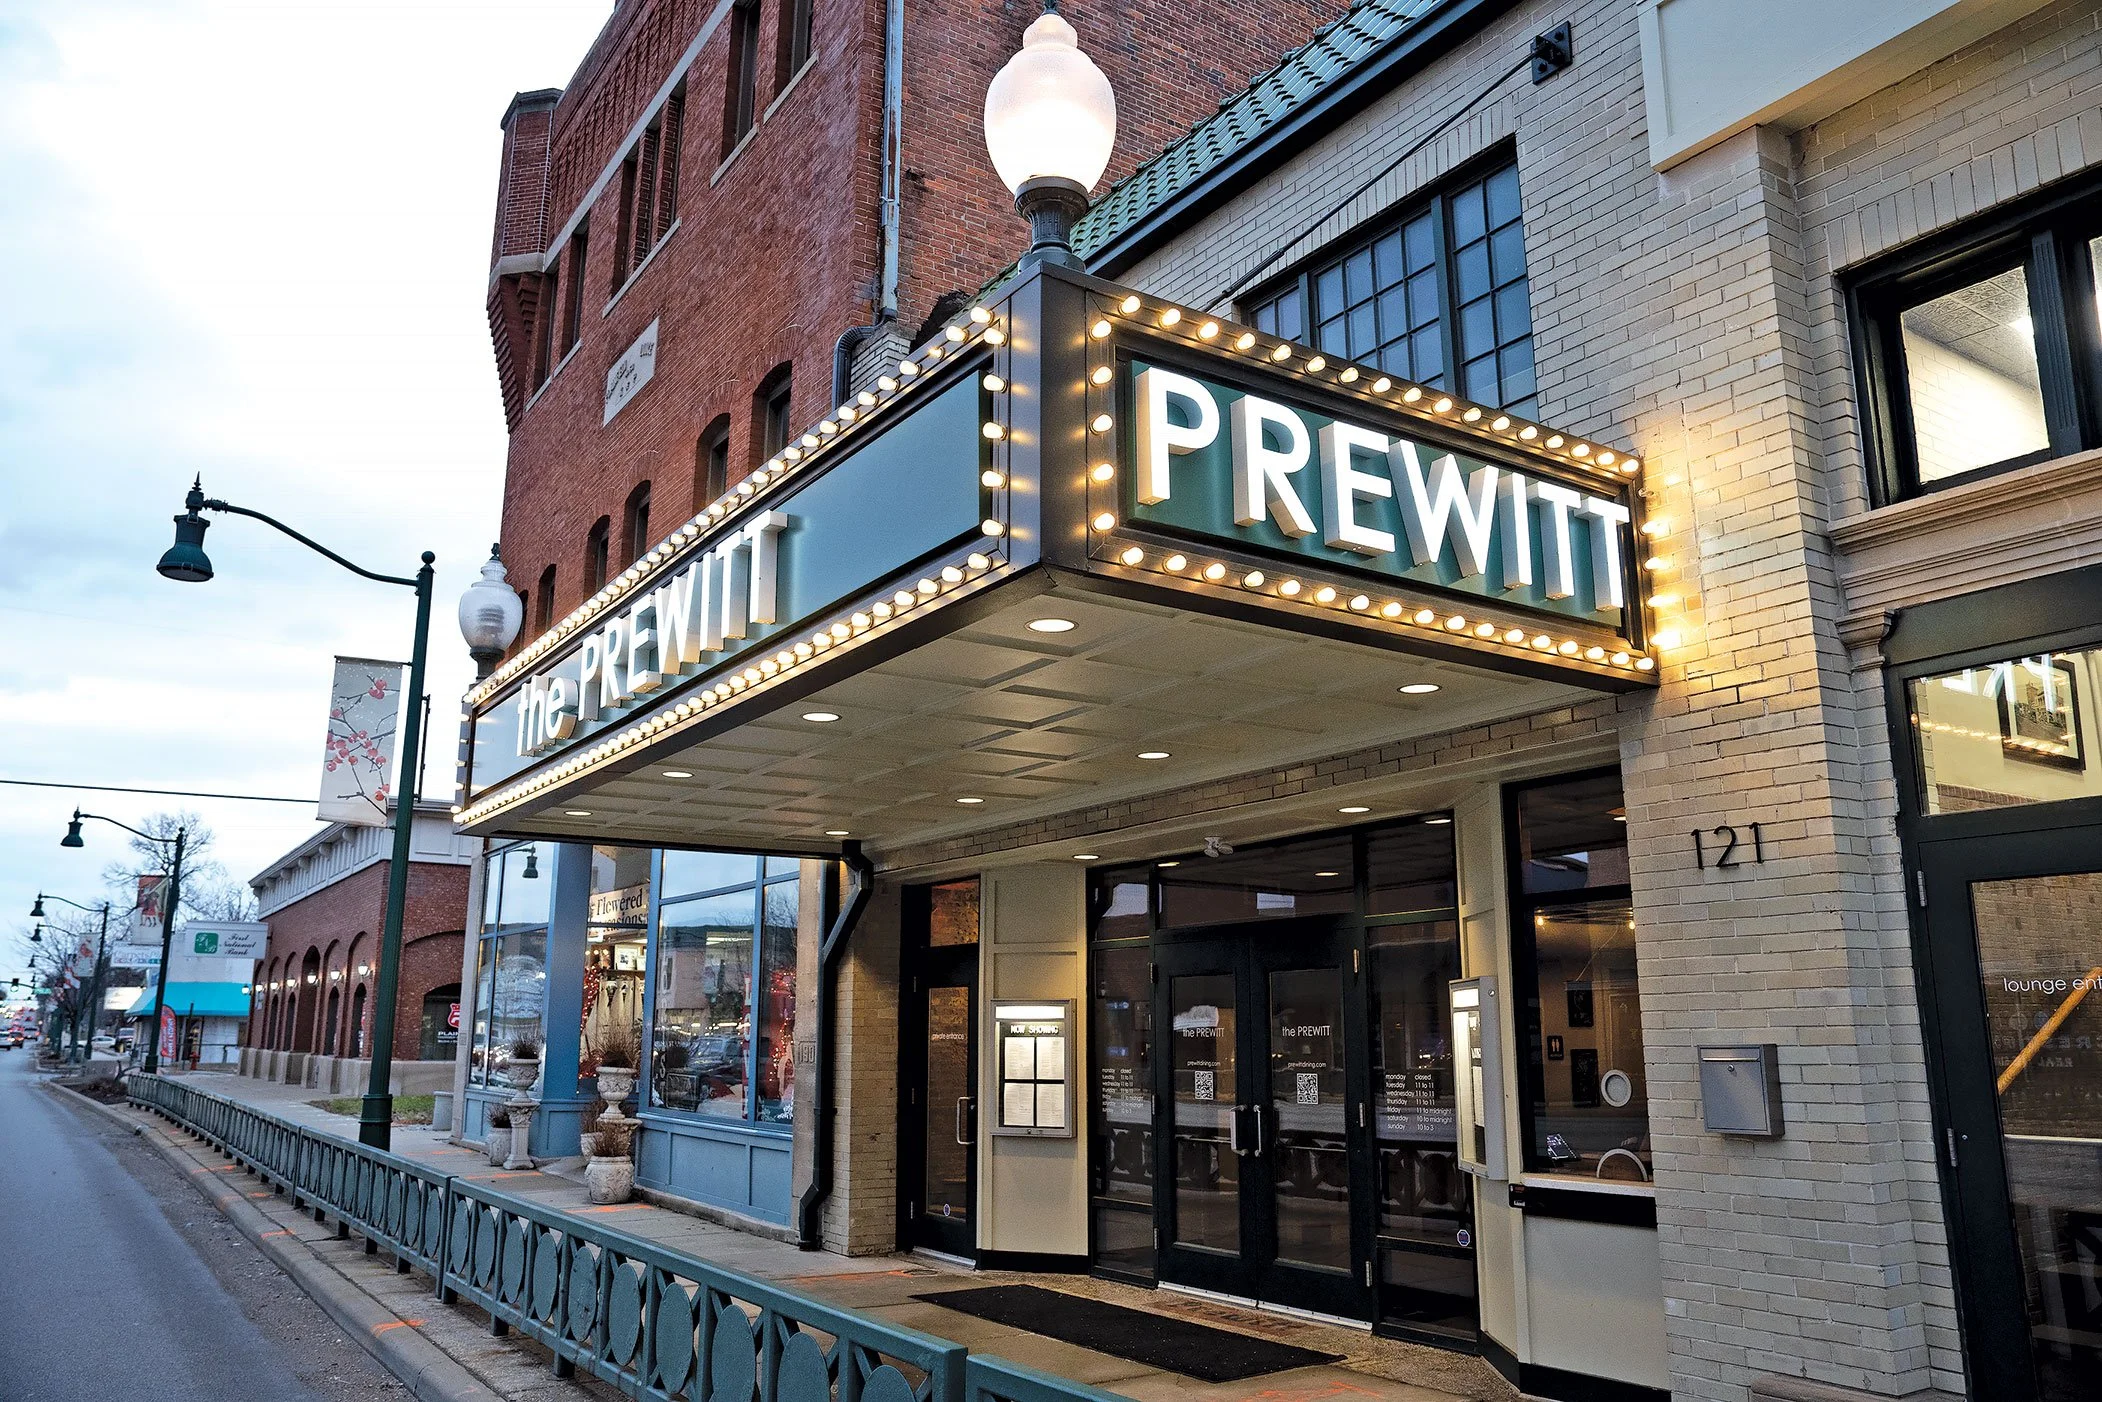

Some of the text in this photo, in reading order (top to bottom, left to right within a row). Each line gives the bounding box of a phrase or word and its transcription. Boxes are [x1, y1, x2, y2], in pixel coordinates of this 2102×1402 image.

[1135, 367, 1630, 612] PREWITT
[517, 509, 788, 757] the PREWITT
[1690, 822, 1763, 870] 121
[2003, 977, 2067, 995] lounge
[1010, 1025, 1059, 1034] NOW SHOWING
[1183, 1027, 1224, 1038] the PREWITT
[1282, 1025, 1331, 1037] the PREWITT
[1430, 1108, 1451, 1116] midnight
[1430, 1116, 1452, 1124] midnight
